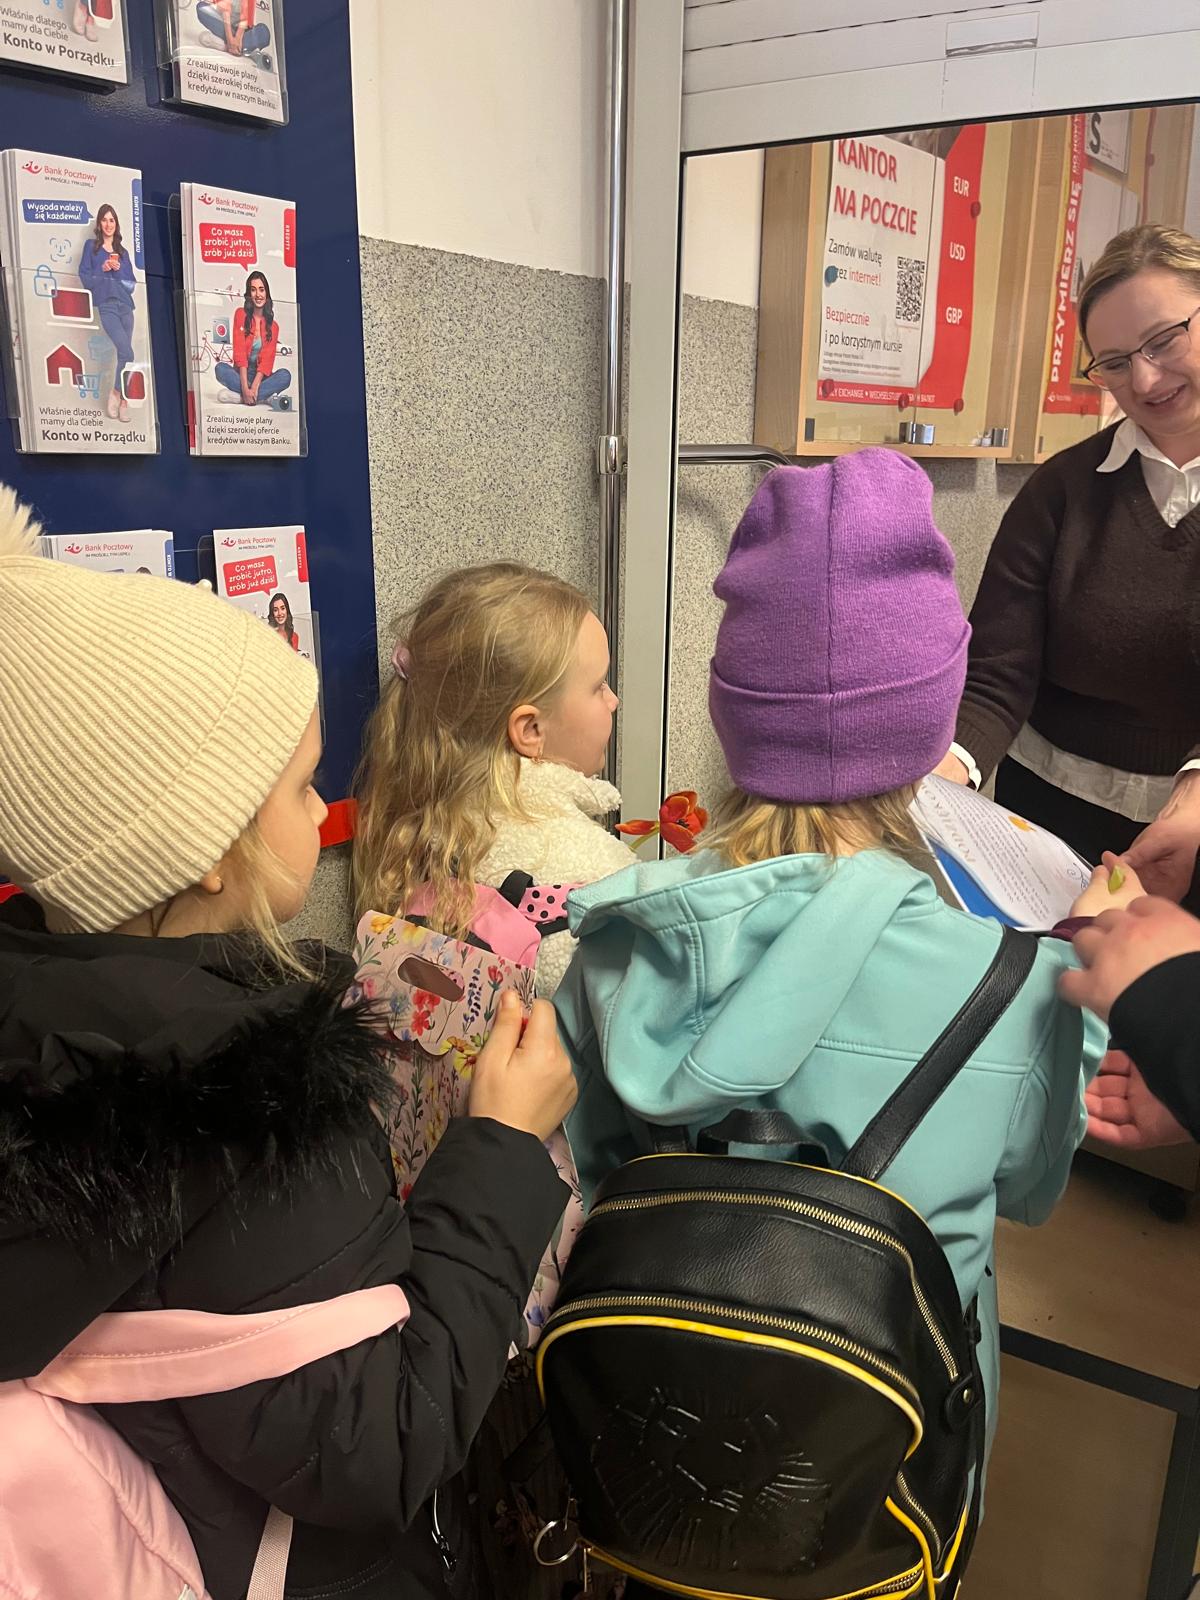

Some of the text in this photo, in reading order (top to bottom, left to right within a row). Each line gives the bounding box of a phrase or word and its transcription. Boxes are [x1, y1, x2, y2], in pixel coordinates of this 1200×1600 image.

[0, 7, 67, 30] Właśnie dlatego
[2, 20, 69, 41] mamy dla Ciebie
[3, 33, 115, 66] Konto w Porządku
[187, 58, 257, 82] Zrealizuj swoje plany
[188, 70, 264, 95] dzięki szerokiej ofercie
[188, 82, 223, 97] kredytów
[232, 92, 256, 105] naszym
[838, 139, 897, 182] KANTOR
[44, 166, 97, 183] Bank Pocztowy
[954, 176, 970, 197] EUR
[28, 202, 84, 216] Wygoda należy
[216, 197, 230, 206] Bank
[232, 200, 259, 212] Pocztowy
[834, 185, 918, 236] NA POCZCIE
[34, 210, 82, 221] się każdemu!
[212, 228, 244, 236] Co masz
[230, 239, 252, 248] jutro,
[950, 242, 966, 260] USD
[204, 248, 254, 258] zrób już dziś!
[828, 238, 882, 268] Zamów walutę
[849, 267, 882, 286] internet!
[1051, 230, 1074, 383] PRZYMIERZ
[1068, 181, 1082, 223] SIĘ
[826, 306, 870, 326] Bezpiecznie
[946, 306, 963, 324] GBP
[825, 330, 902, 352] i po korzystnym kursie
[838, 388, 864, 398] EXCHANGE
[40, 407, 102, 418] Właśnie dlatego
[40, 418, 66, 426] mamy
[80, 418, 104, 426] Ciebie
[206, 416, 234, 424] Zrealizuj
[256, 416, 273, 426] plany
[42, 430, 146, 444] Konto w Porządku
[207, 426, 226, 434] dzięki
[228, 426, 256, 436] szerokiej
[208, 436, 238, 446] kredytów
[246, 438, 270, 446] naszym
[85, 544, 102, 552] Bank
[229, 568, 273, 582] zrobić jutro,
[235, 562, 265, 572] Co masz
[229, 576, 275, 592] zrób już dziś!
